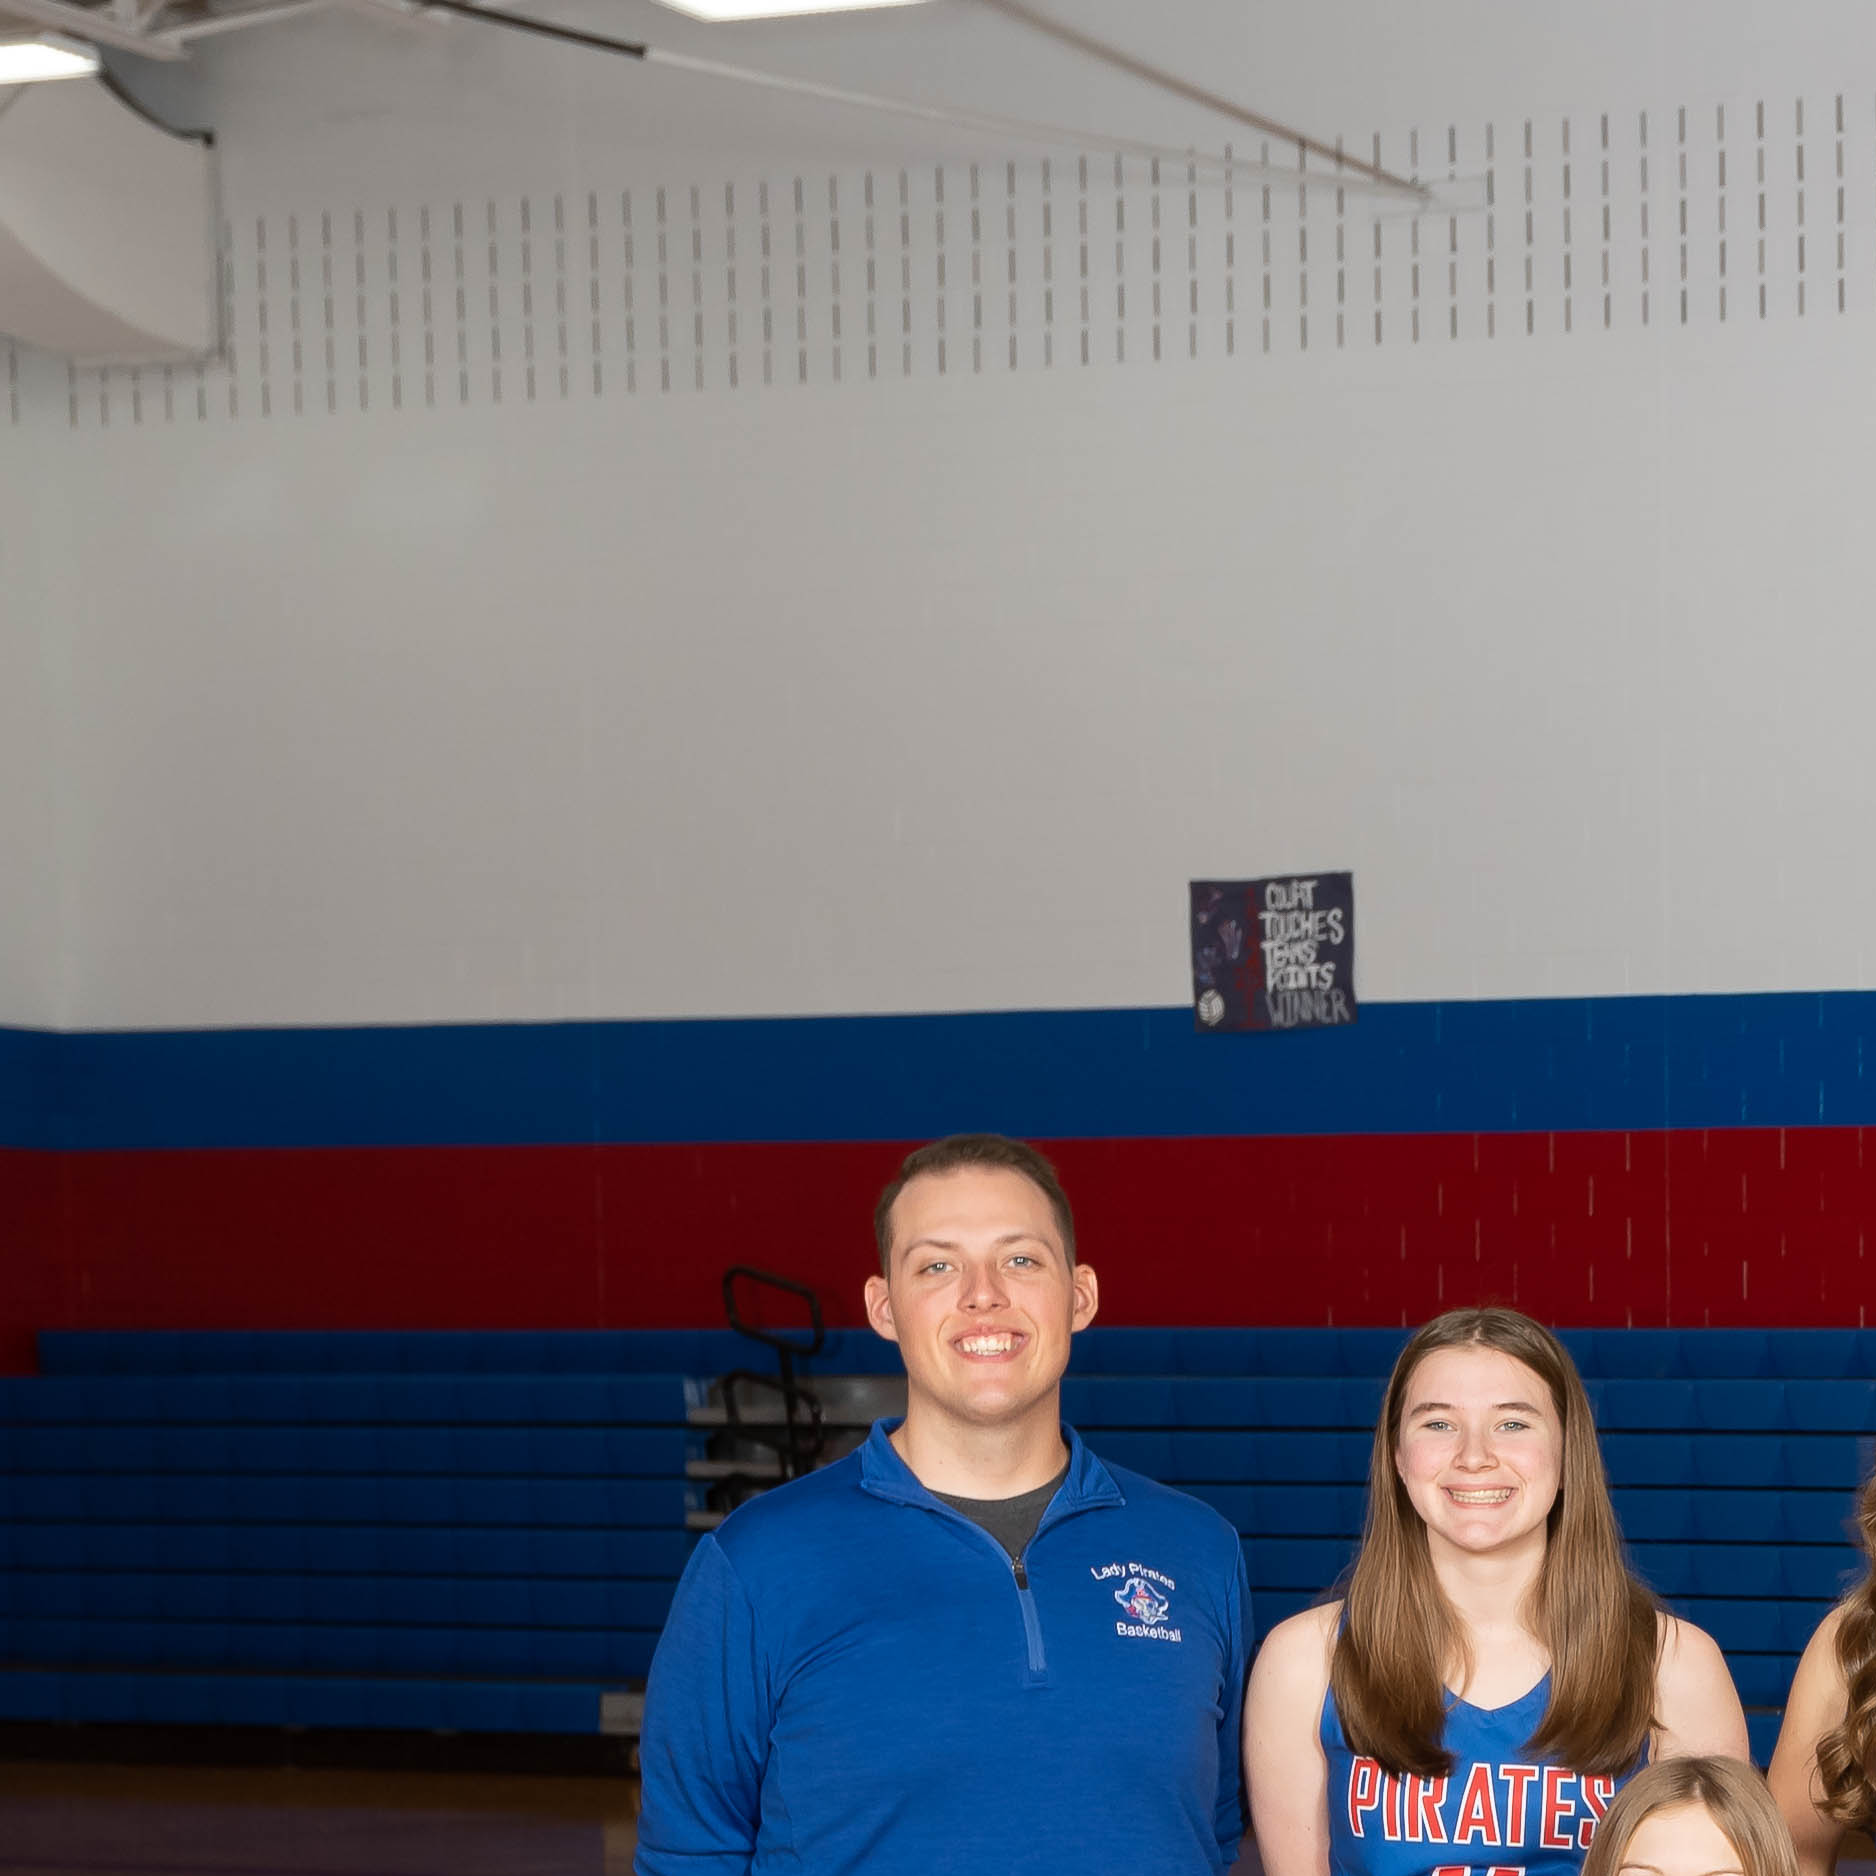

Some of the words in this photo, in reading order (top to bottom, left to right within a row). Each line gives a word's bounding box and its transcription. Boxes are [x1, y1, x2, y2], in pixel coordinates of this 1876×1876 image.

[1090, 1562, 1126, 1581] Lady
[1128, 1562, 1176, 1591] Pirates
[1116, 1621, 1183, 1643] Basketball
